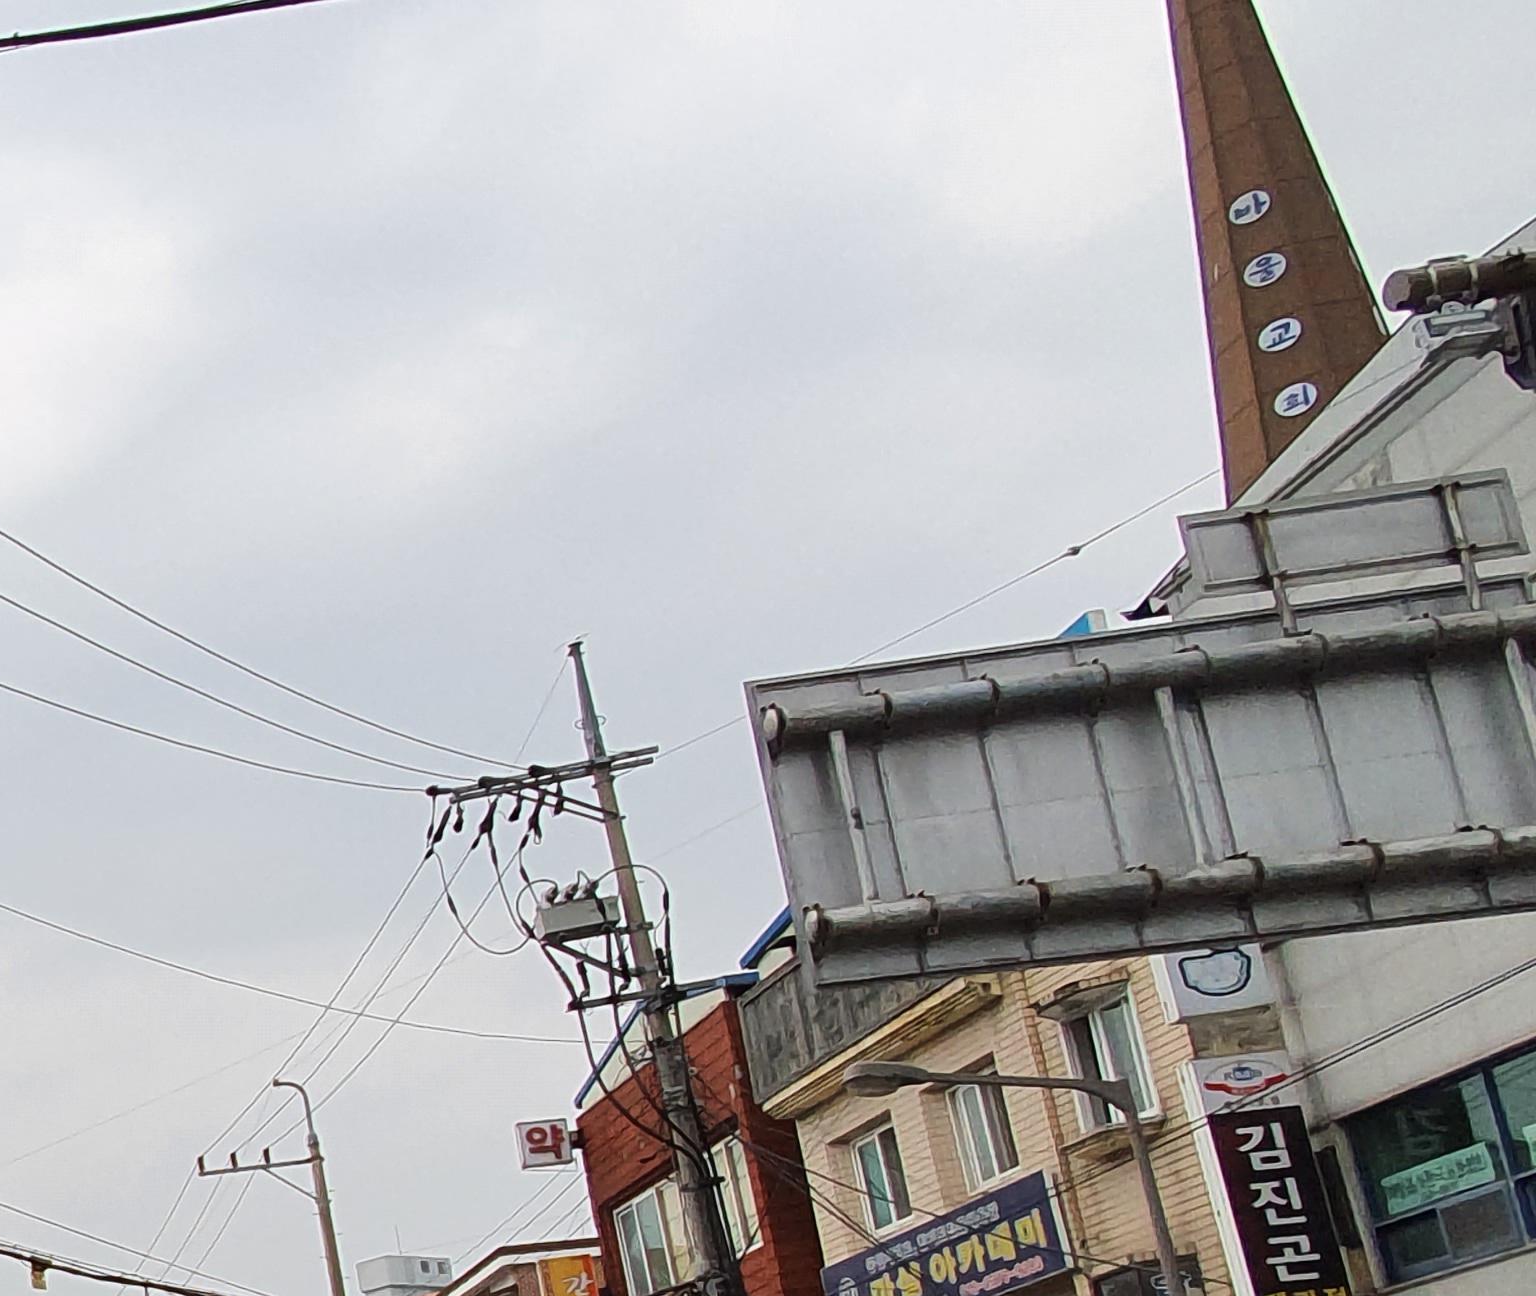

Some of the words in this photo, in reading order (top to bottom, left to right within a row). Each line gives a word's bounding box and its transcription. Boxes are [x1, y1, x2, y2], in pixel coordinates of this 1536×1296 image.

[1234, 192, 1312, 413] 마을교회
[525, 1123, 566, 1160] 약
[1234, 1121, 1322, 1284] 김진곤
